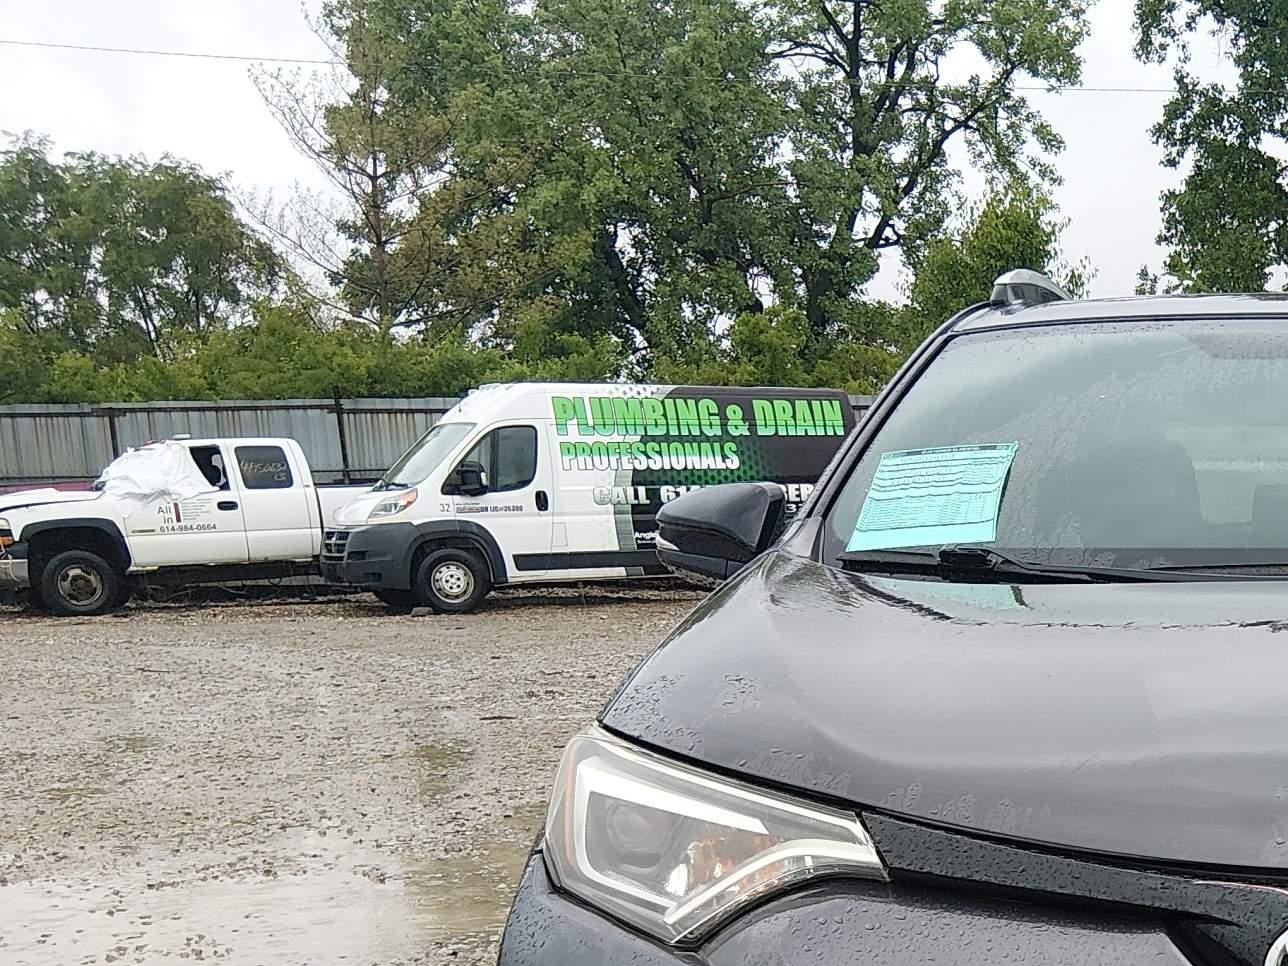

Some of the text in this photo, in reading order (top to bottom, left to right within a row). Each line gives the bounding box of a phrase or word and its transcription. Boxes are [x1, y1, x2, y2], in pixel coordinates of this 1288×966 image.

[552, 396, 845, 436] PLUMBING & DRAIN
[560, 441, 741, 471] PROFESSIONALS
[440, 503, 451, 513] 32
[593, 485, 650, 506] CALL
